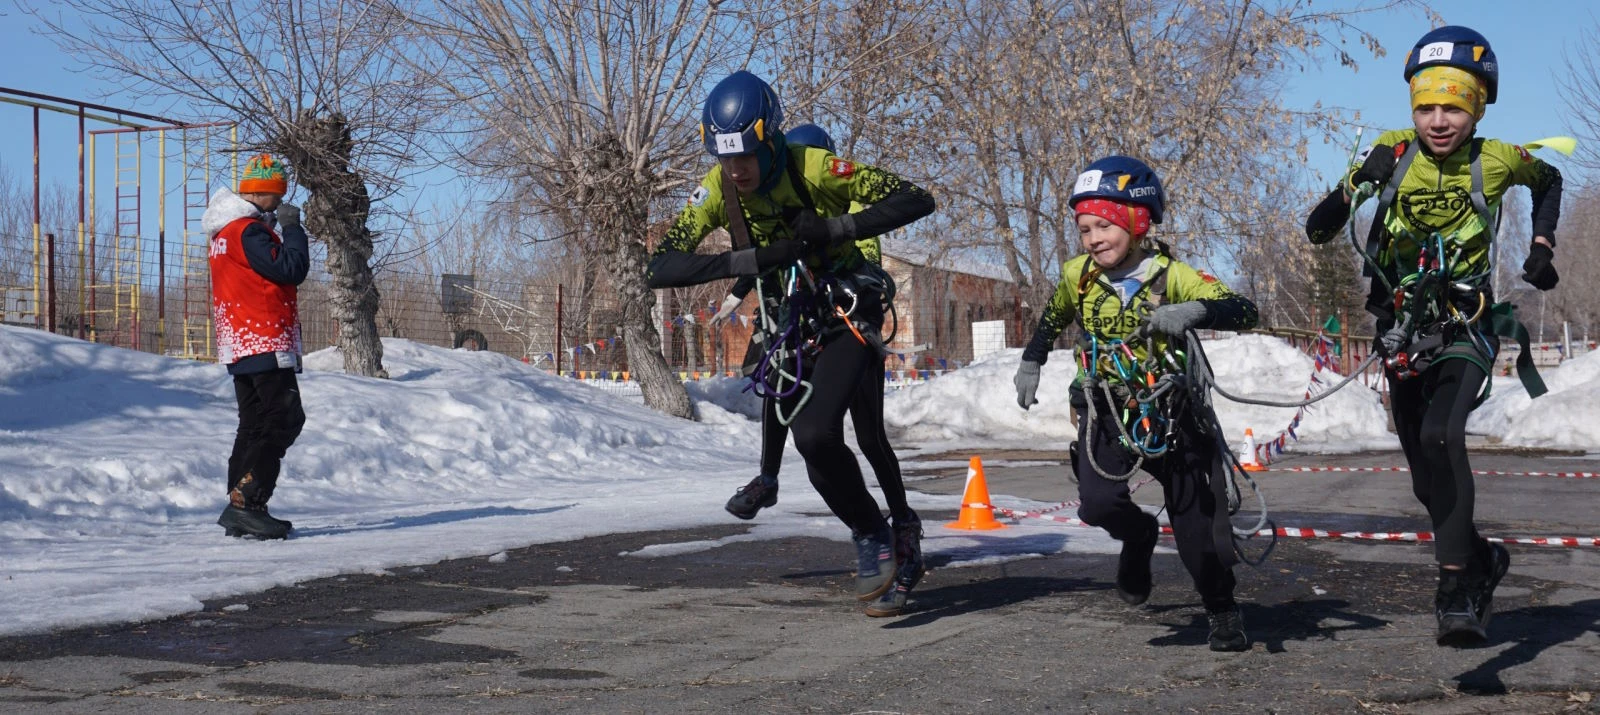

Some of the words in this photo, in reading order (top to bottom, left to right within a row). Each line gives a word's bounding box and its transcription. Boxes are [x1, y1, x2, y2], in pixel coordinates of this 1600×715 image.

[1429, 47, 1443, 57] 20
[723, 138, 735, 149] 14
[1083, 176, 1093, 187] 19
[1129, 186, 1156, 198] VENTO
